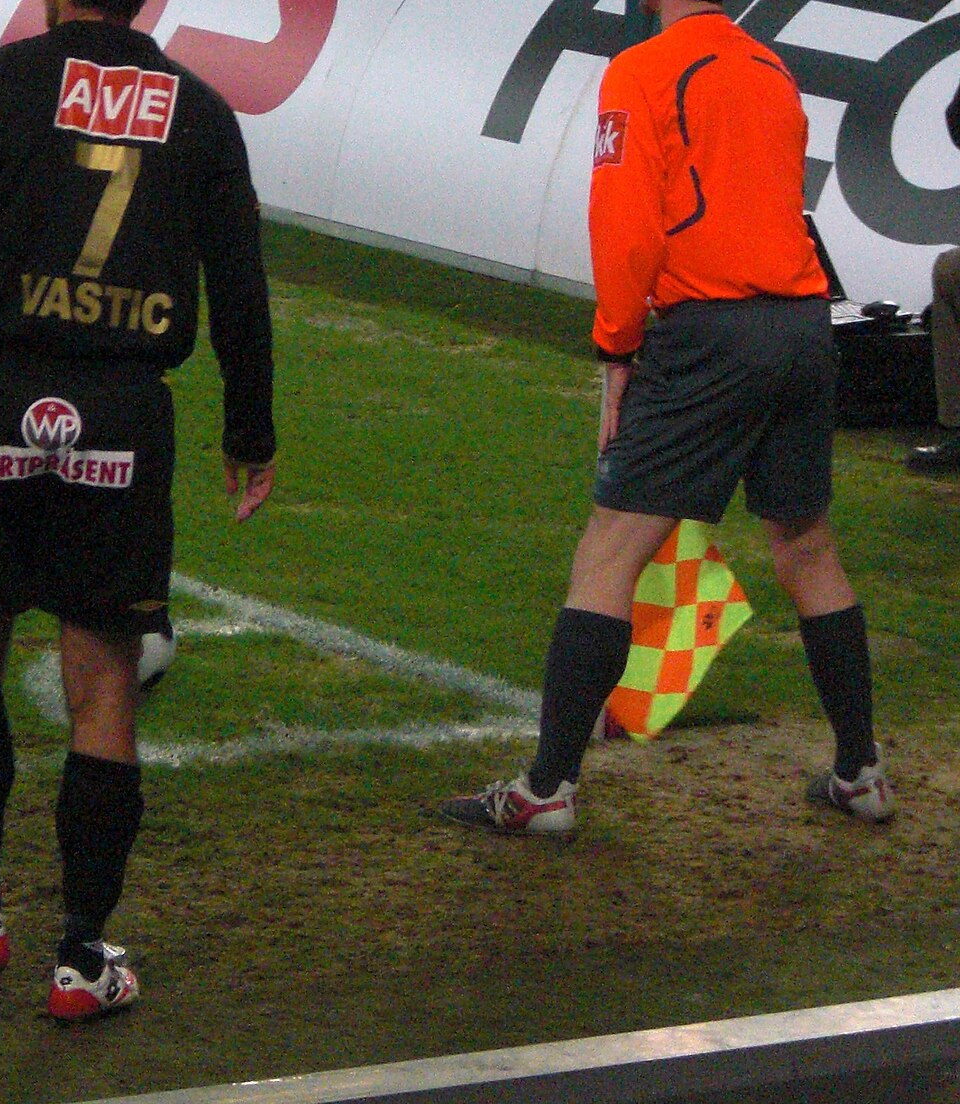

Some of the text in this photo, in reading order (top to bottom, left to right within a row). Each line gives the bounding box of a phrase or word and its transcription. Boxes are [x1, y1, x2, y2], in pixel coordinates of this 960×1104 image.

[61, 77, 170, 122] AVE
[74, 141, 142, 277] 7
[21, 273, 174, 335] VASTIC
[26, 410, 80, 446] WP
